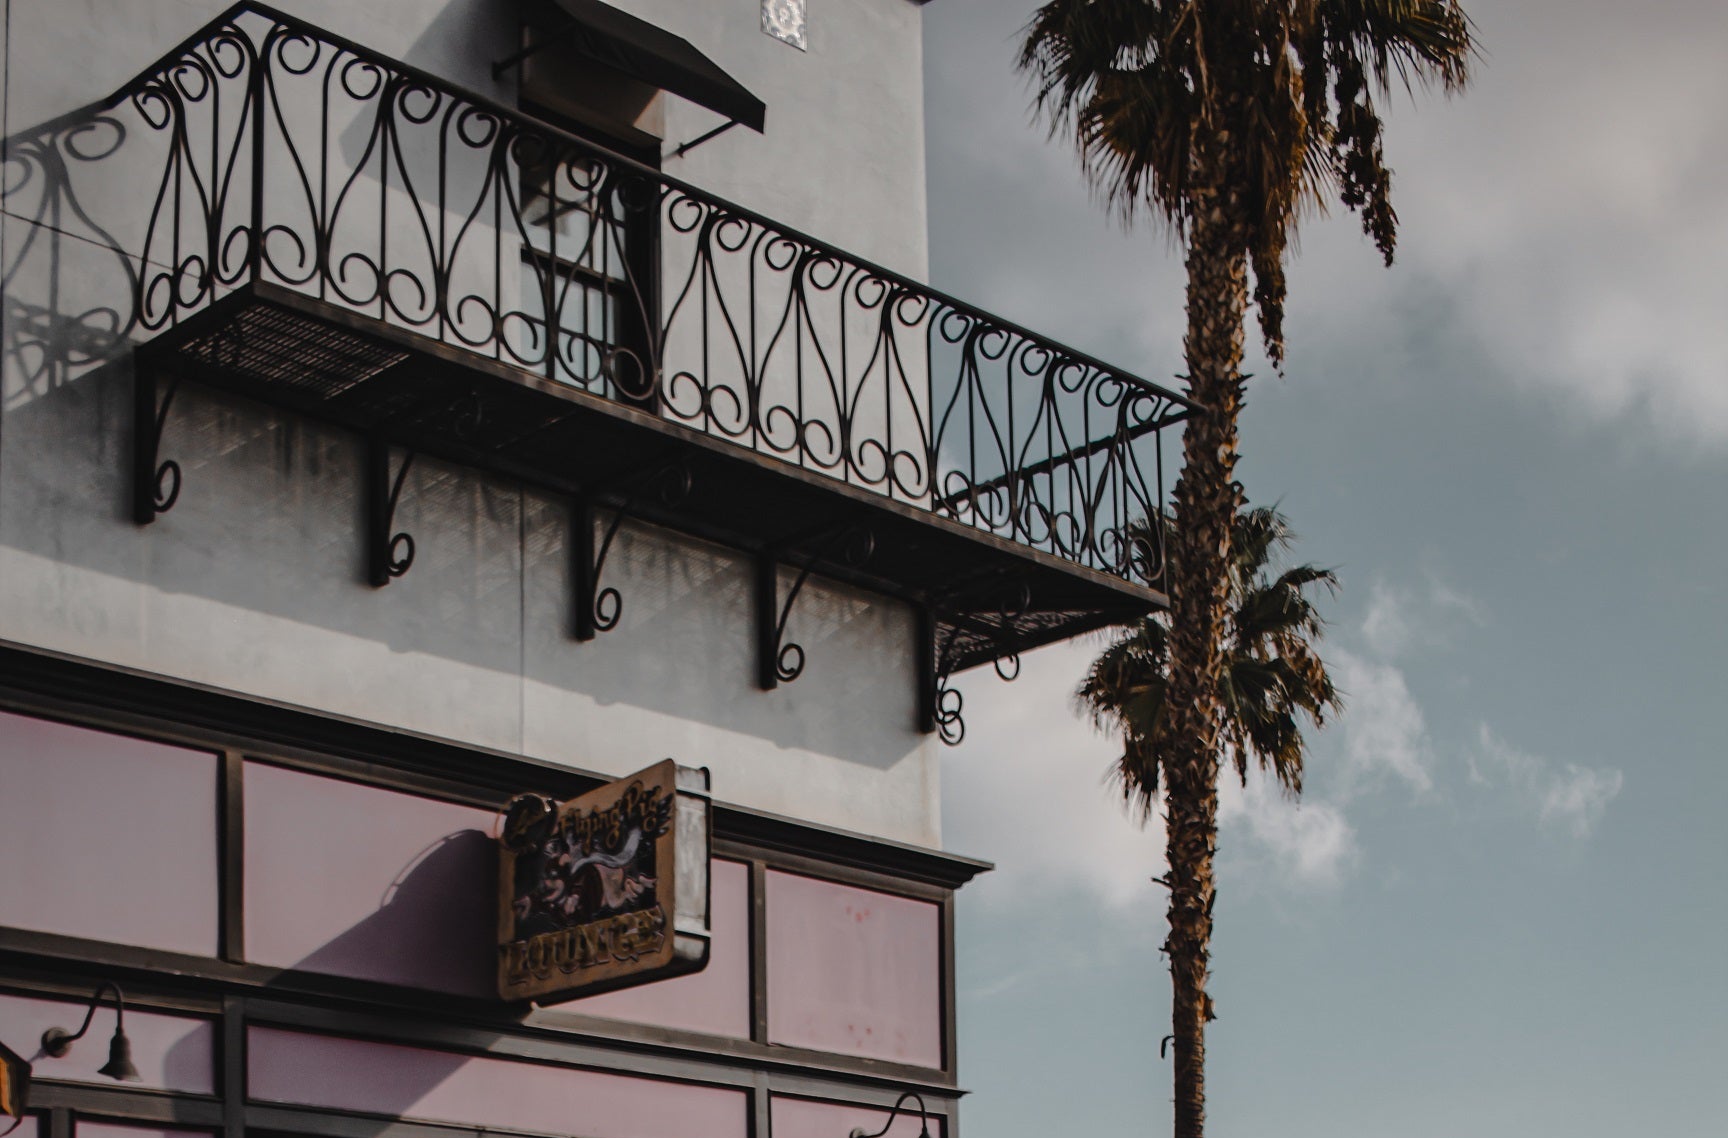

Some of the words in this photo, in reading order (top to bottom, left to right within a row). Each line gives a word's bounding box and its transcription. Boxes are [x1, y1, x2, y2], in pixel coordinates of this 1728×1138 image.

[559, 802, 621, 855] Flying
[622, 780, 662, 832] Pig
[500, 905, 665, 985] LOUNGE
